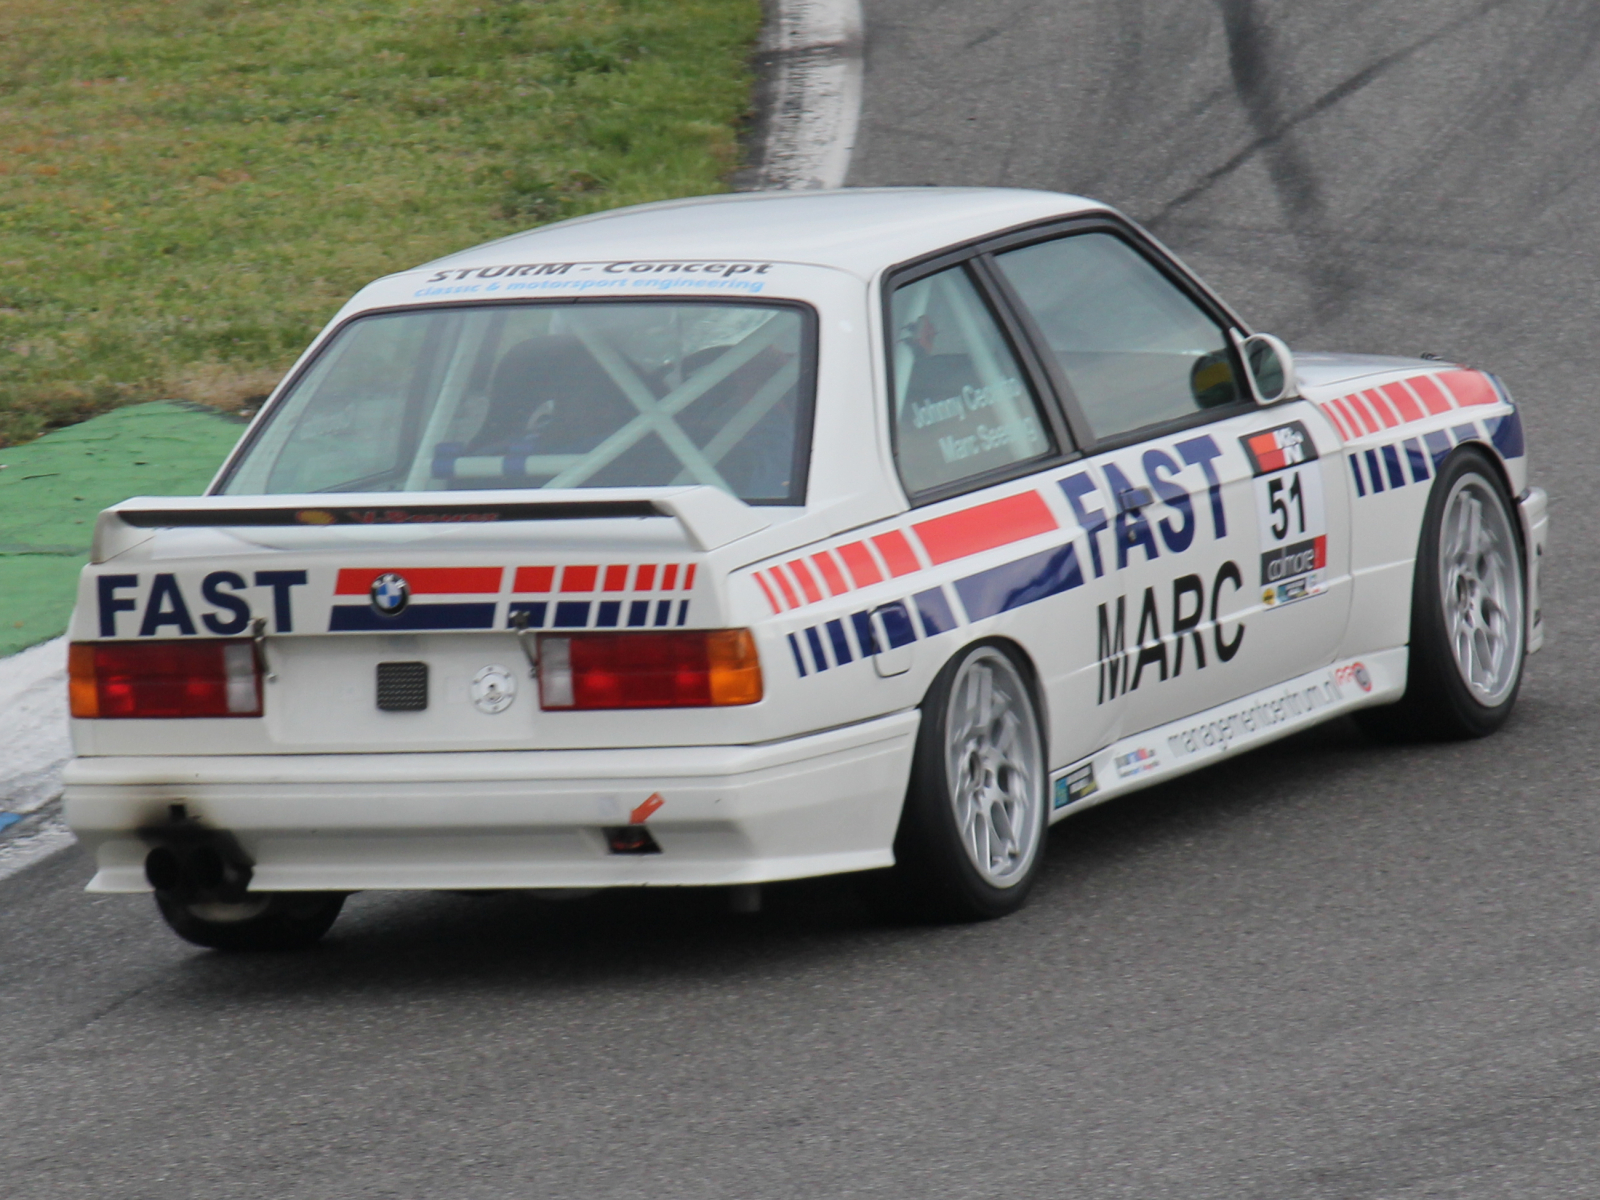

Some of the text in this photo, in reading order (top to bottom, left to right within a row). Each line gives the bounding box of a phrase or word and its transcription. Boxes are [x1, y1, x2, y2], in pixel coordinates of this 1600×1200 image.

[413, 285, 481, 297] classic
[506, 279, 628, 292] motorsport
[632, 277, 765, 293] engineering
[427, 262, 575, 283] STURM
[602, 261, 772, 278] Concept
[1056, 434, 1228, 579] FAST
[1268, 471, 1306, 540] 51
[98, 569, 307, 637] FAST
[1098, 560, 1246, 706] MARC
